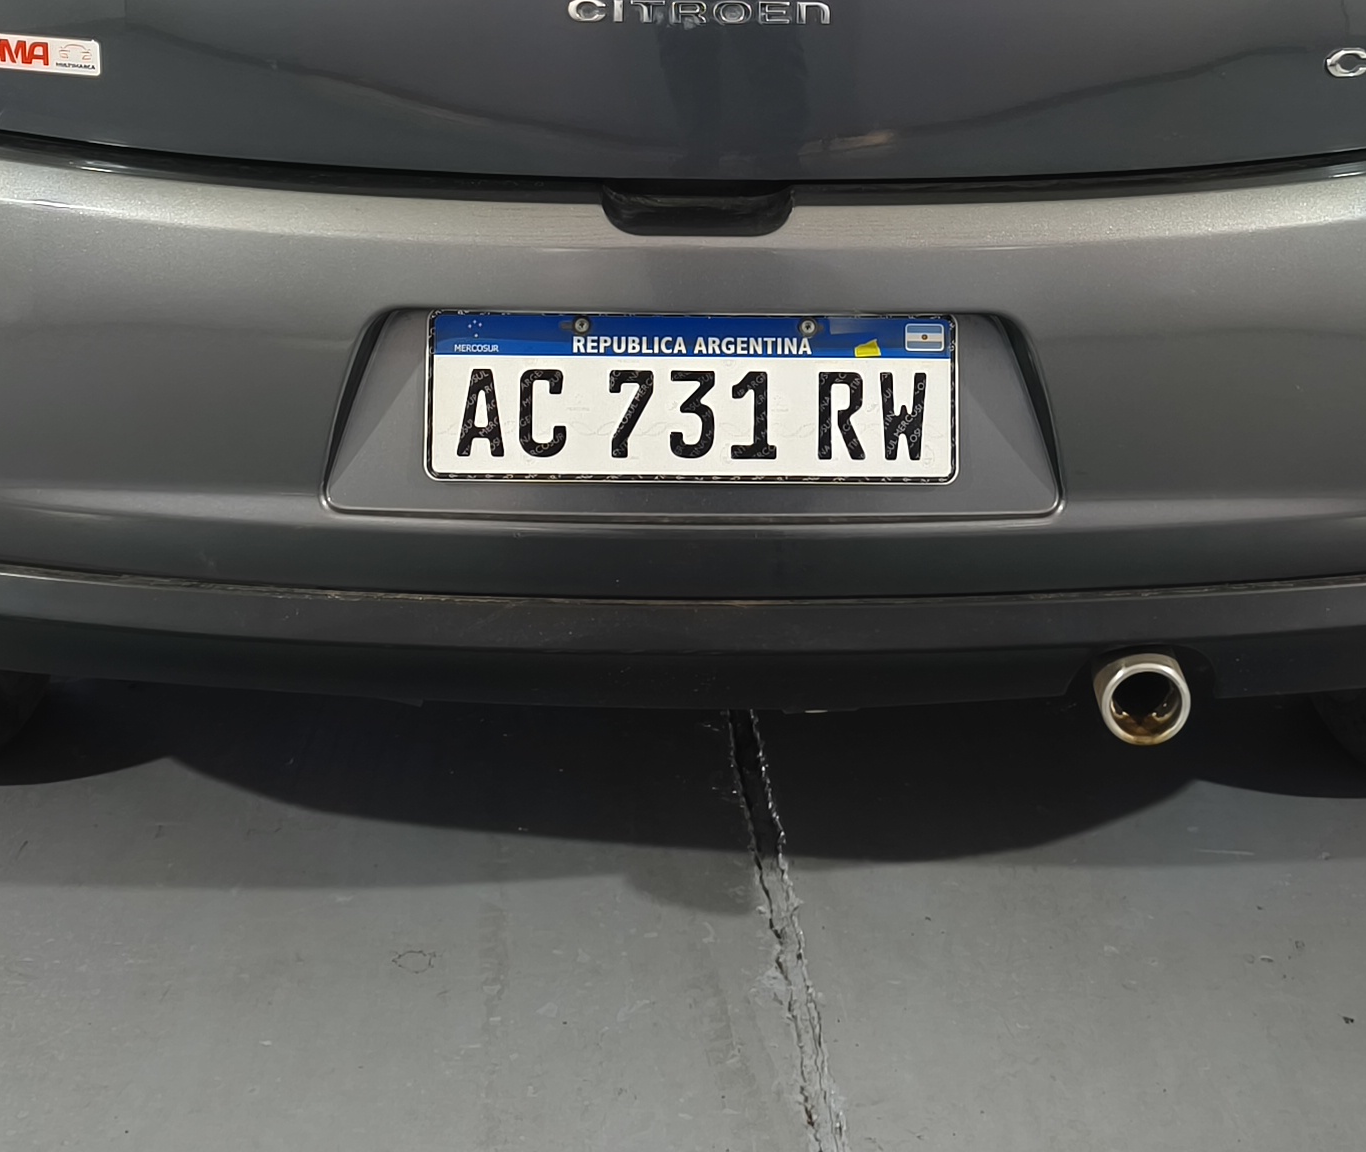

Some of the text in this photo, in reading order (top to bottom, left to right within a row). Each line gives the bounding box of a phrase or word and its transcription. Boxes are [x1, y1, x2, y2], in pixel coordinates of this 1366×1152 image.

[453, 343, 499, 353] MERCOSUR
[572, 335, 813, 356] REPUBLICA ARGENTINA
[456, 368, 927, 461] AC 731 RW
